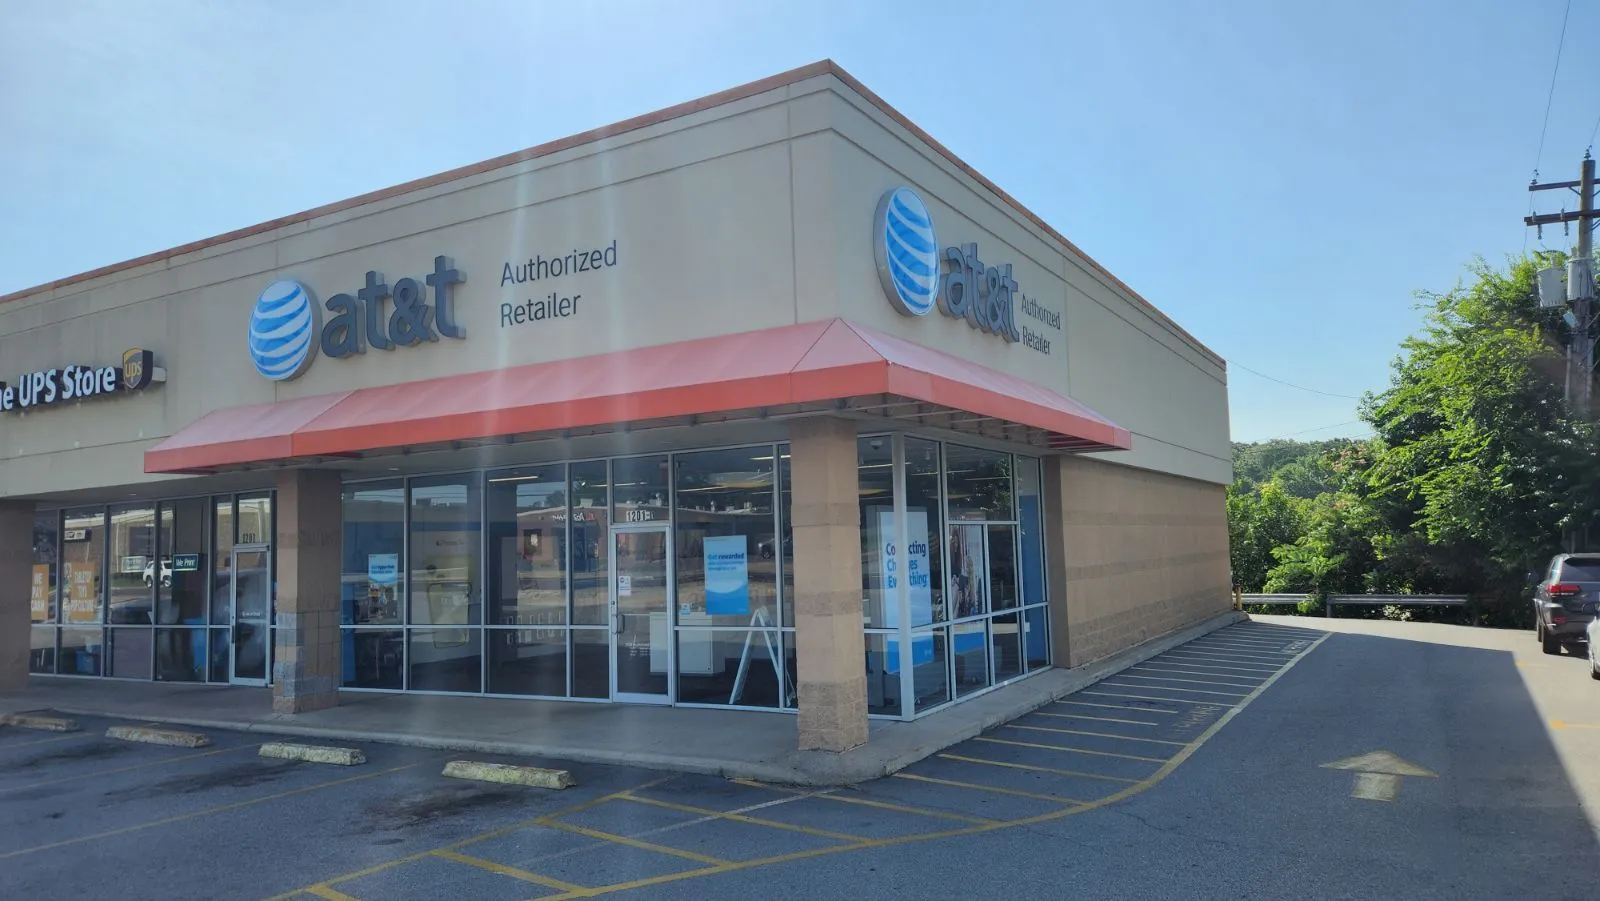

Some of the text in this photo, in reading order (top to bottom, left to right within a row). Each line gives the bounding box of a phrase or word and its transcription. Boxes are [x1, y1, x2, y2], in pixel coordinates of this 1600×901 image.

[501, 240, 617, 287] Authorized
[320, 255, 466, 359] at&t
[500, 293, 581, 328] Retailer
[937, 242, 1019, 342] at&t
[1021, 293, 1061, 330] Authorized
[1022, 325, 1050, 355] Retailer
[19, 369, 57, 407] UPS
[62, 364, 116, 399] Store
[125, 360, 142, 382] ups
[886, 540, 926, 557] Cocting
